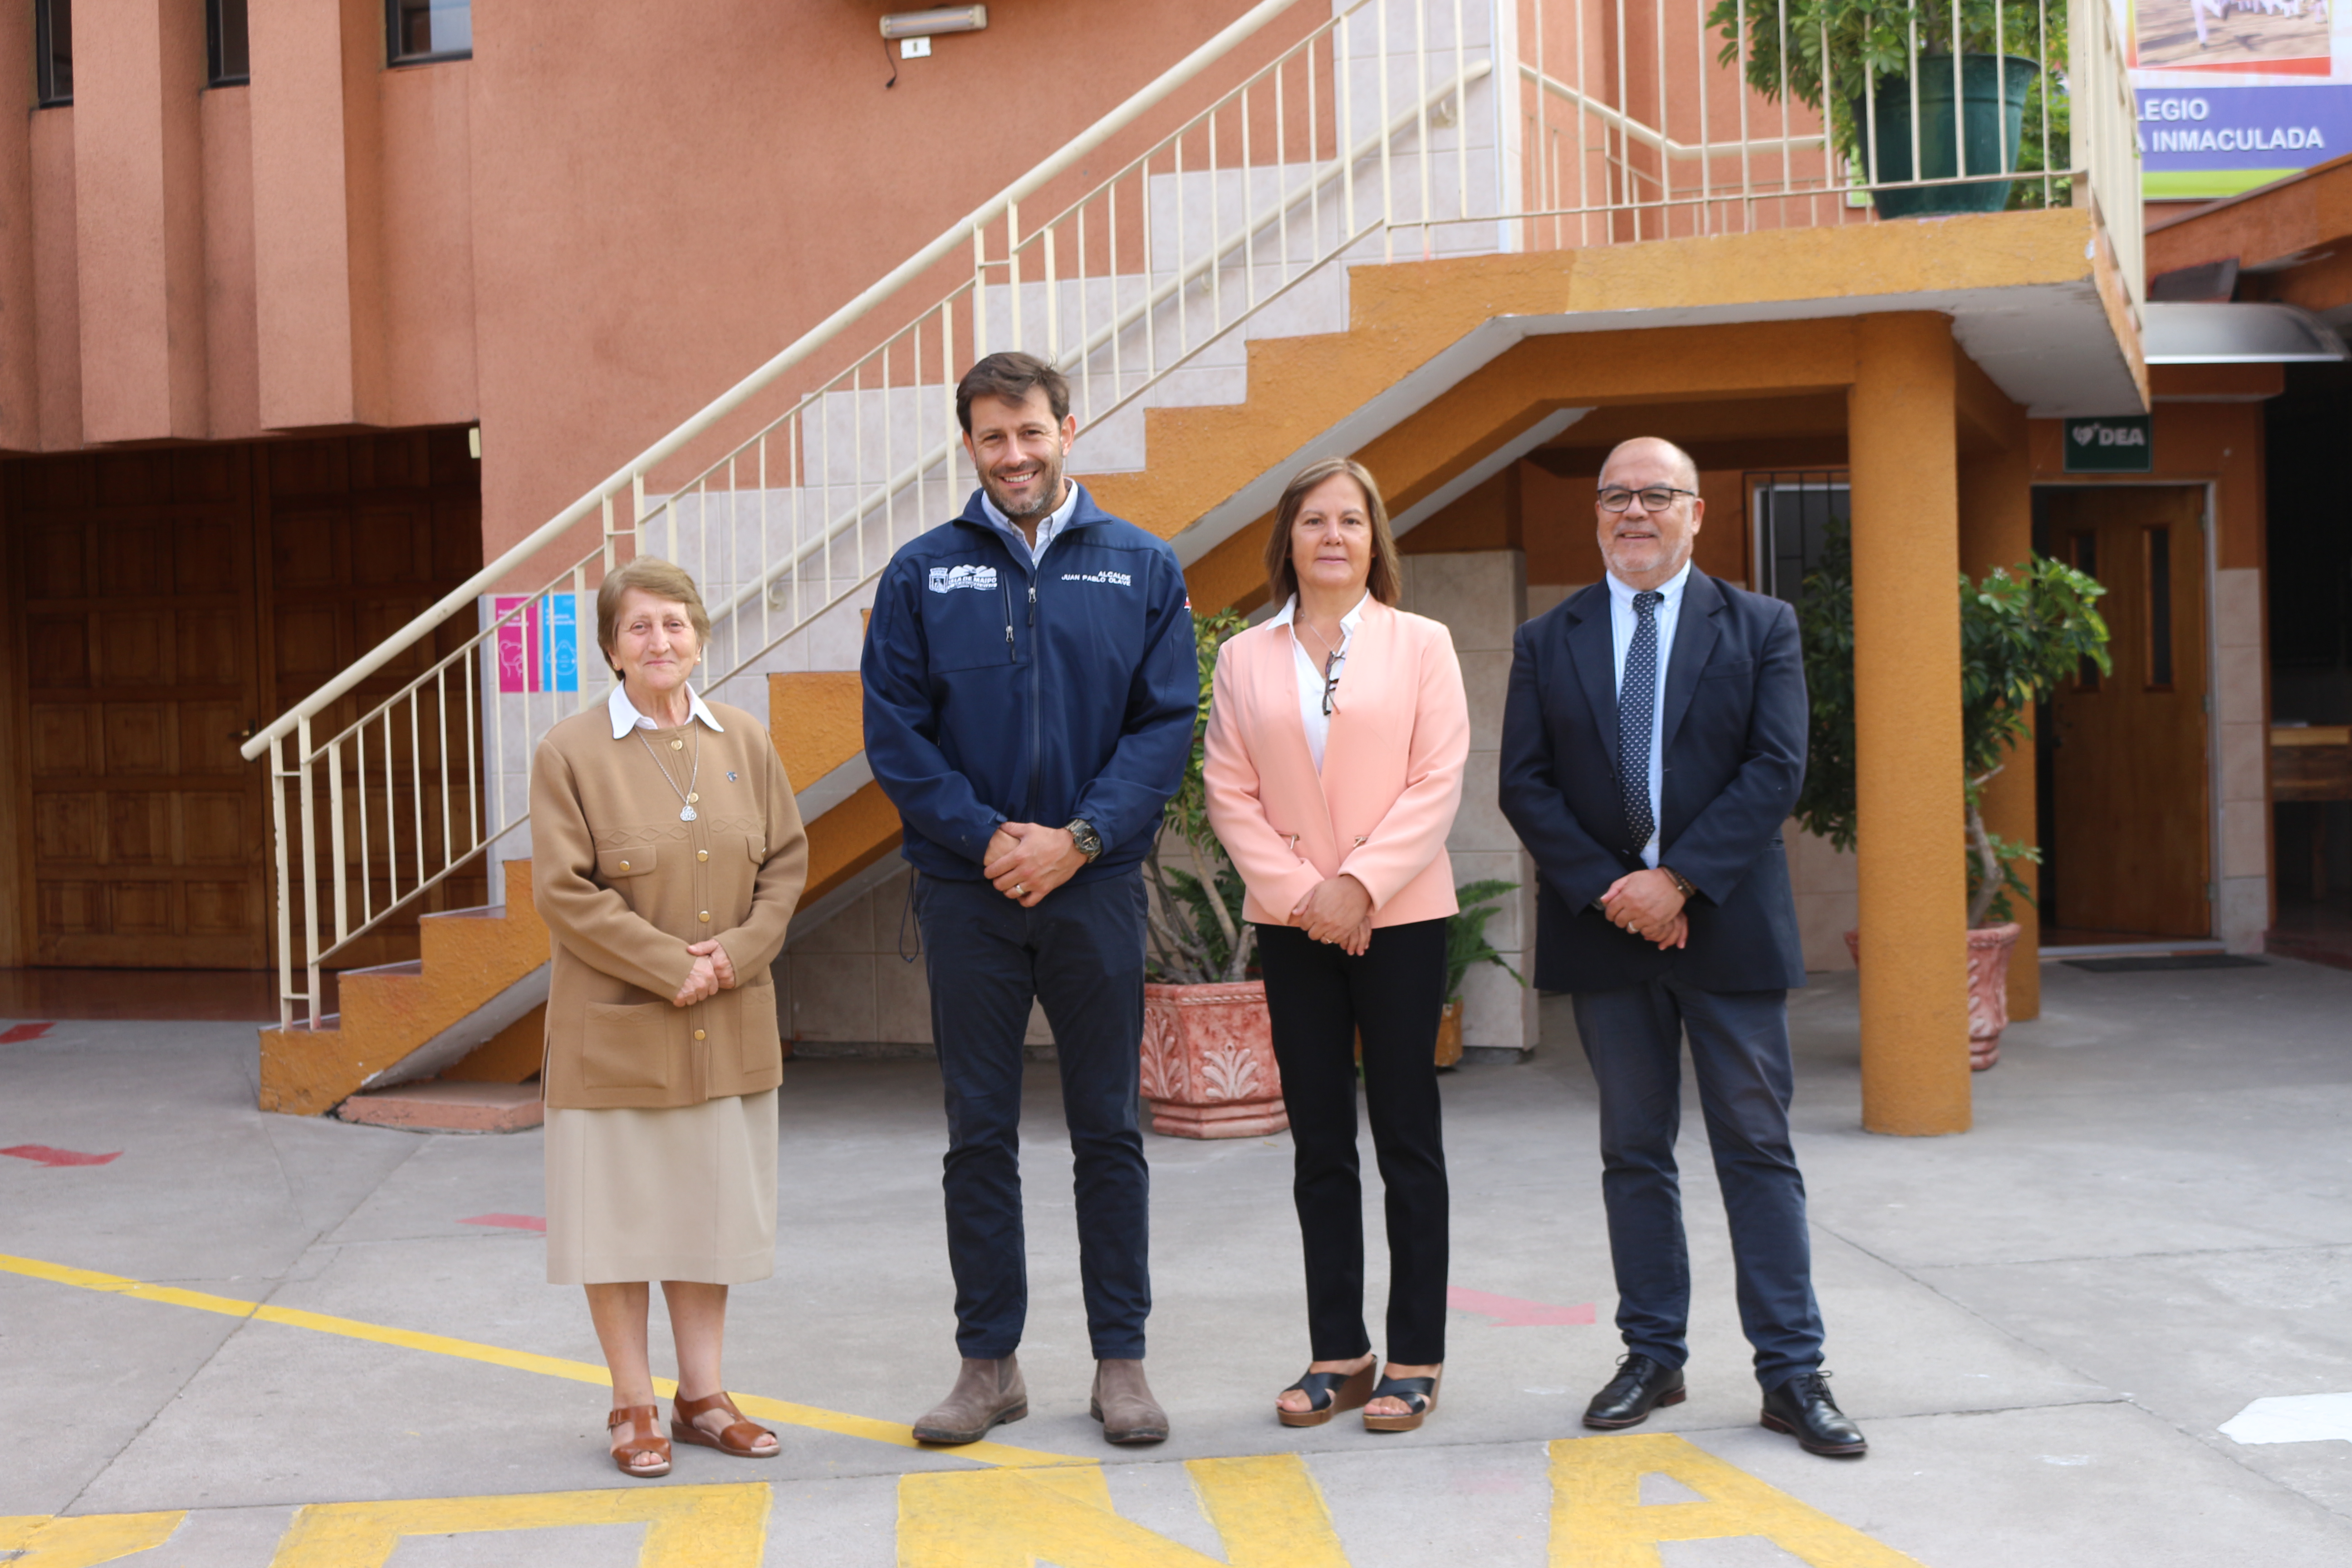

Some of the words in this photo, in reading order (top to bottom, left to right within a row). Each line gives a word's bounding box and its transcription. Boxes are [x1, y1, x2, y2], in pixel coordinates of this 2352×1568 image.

[2152, 126, 2326, 153] INMACULADA
[2098, 428, 2145, 446] DEA
[1082, 574, 1106, 583] PABLO
[1108, 578, 1131, 587] OLAVE
[1098, 571, 1131, 581] ALCALDE
